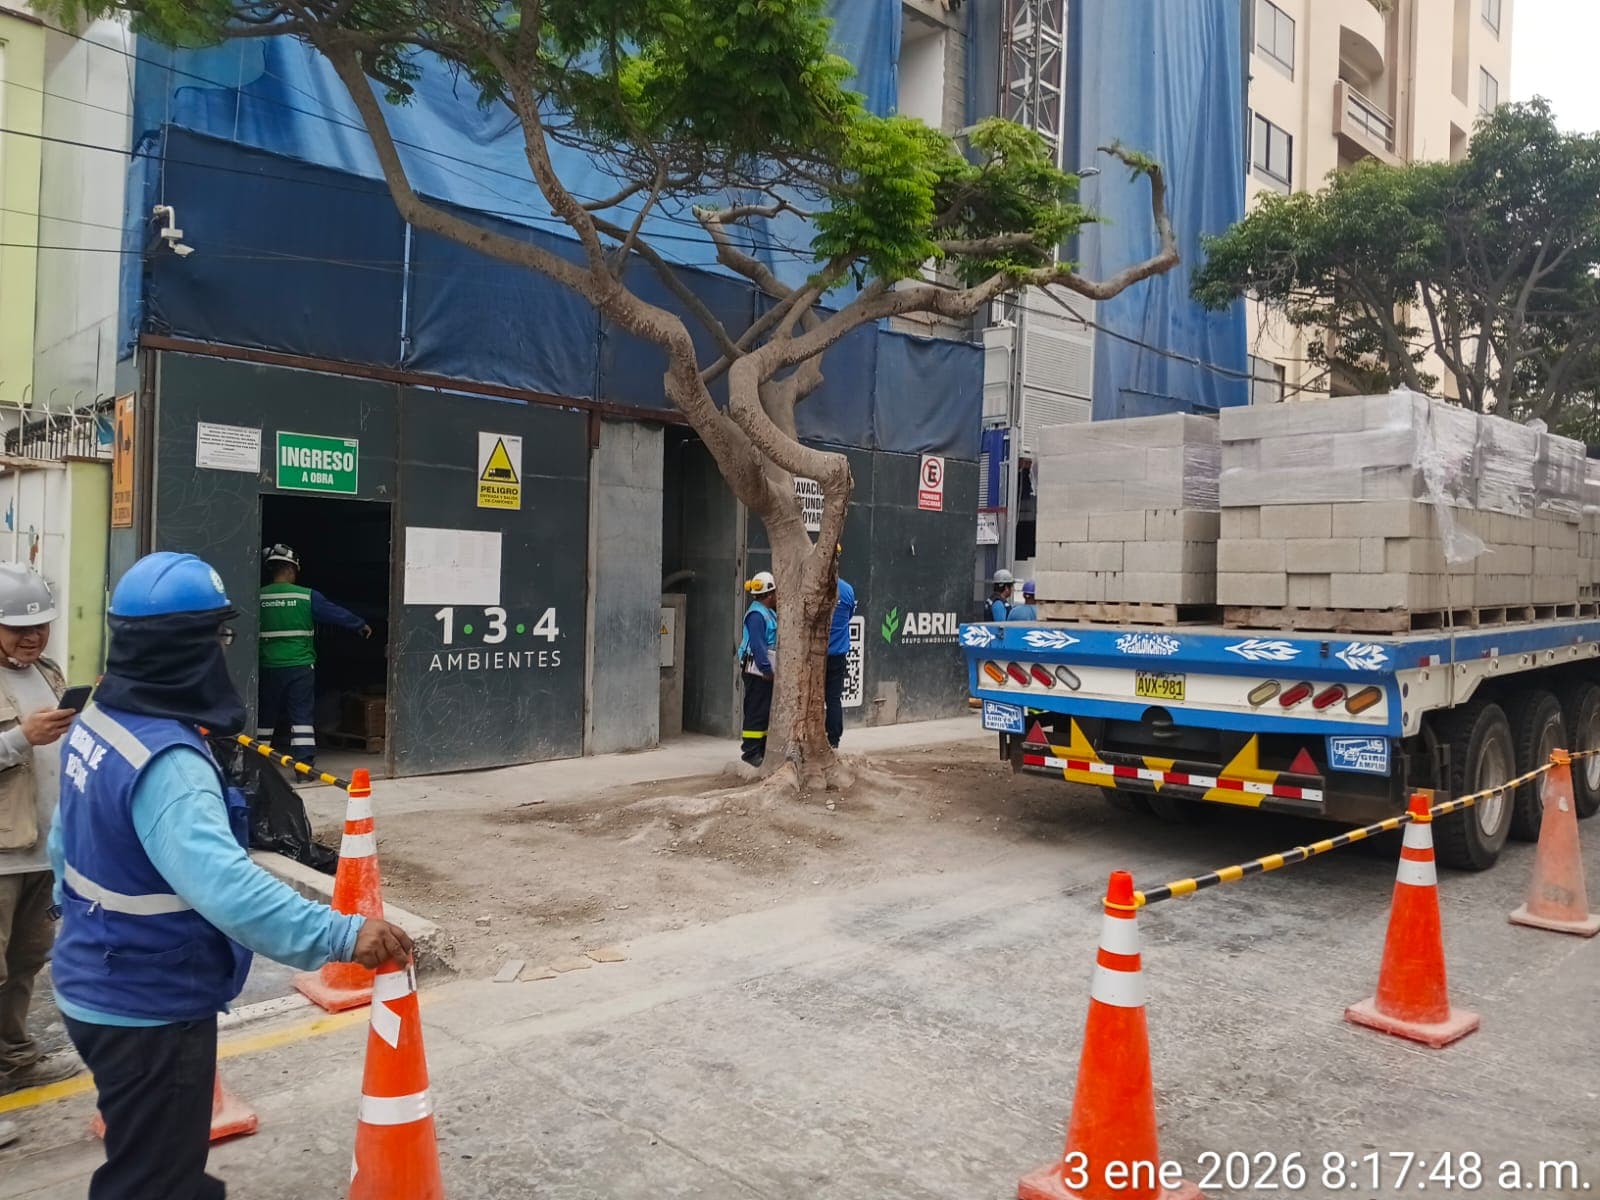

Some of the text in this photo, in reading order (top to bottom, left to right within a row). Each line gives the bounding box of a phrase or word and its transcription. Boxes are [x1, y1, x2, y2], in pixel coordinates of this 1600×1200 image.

[281, 445, 354, 473] INGRESO
[301, 471, 334, 485] A OBRA
[480, 485, 519, 496] PELIGRO
[901, 612, 959, 635] ABRIL
[428, 650, 562, 672] AMBIENTES
[1137, 677, 1183, 696] AVX-981
